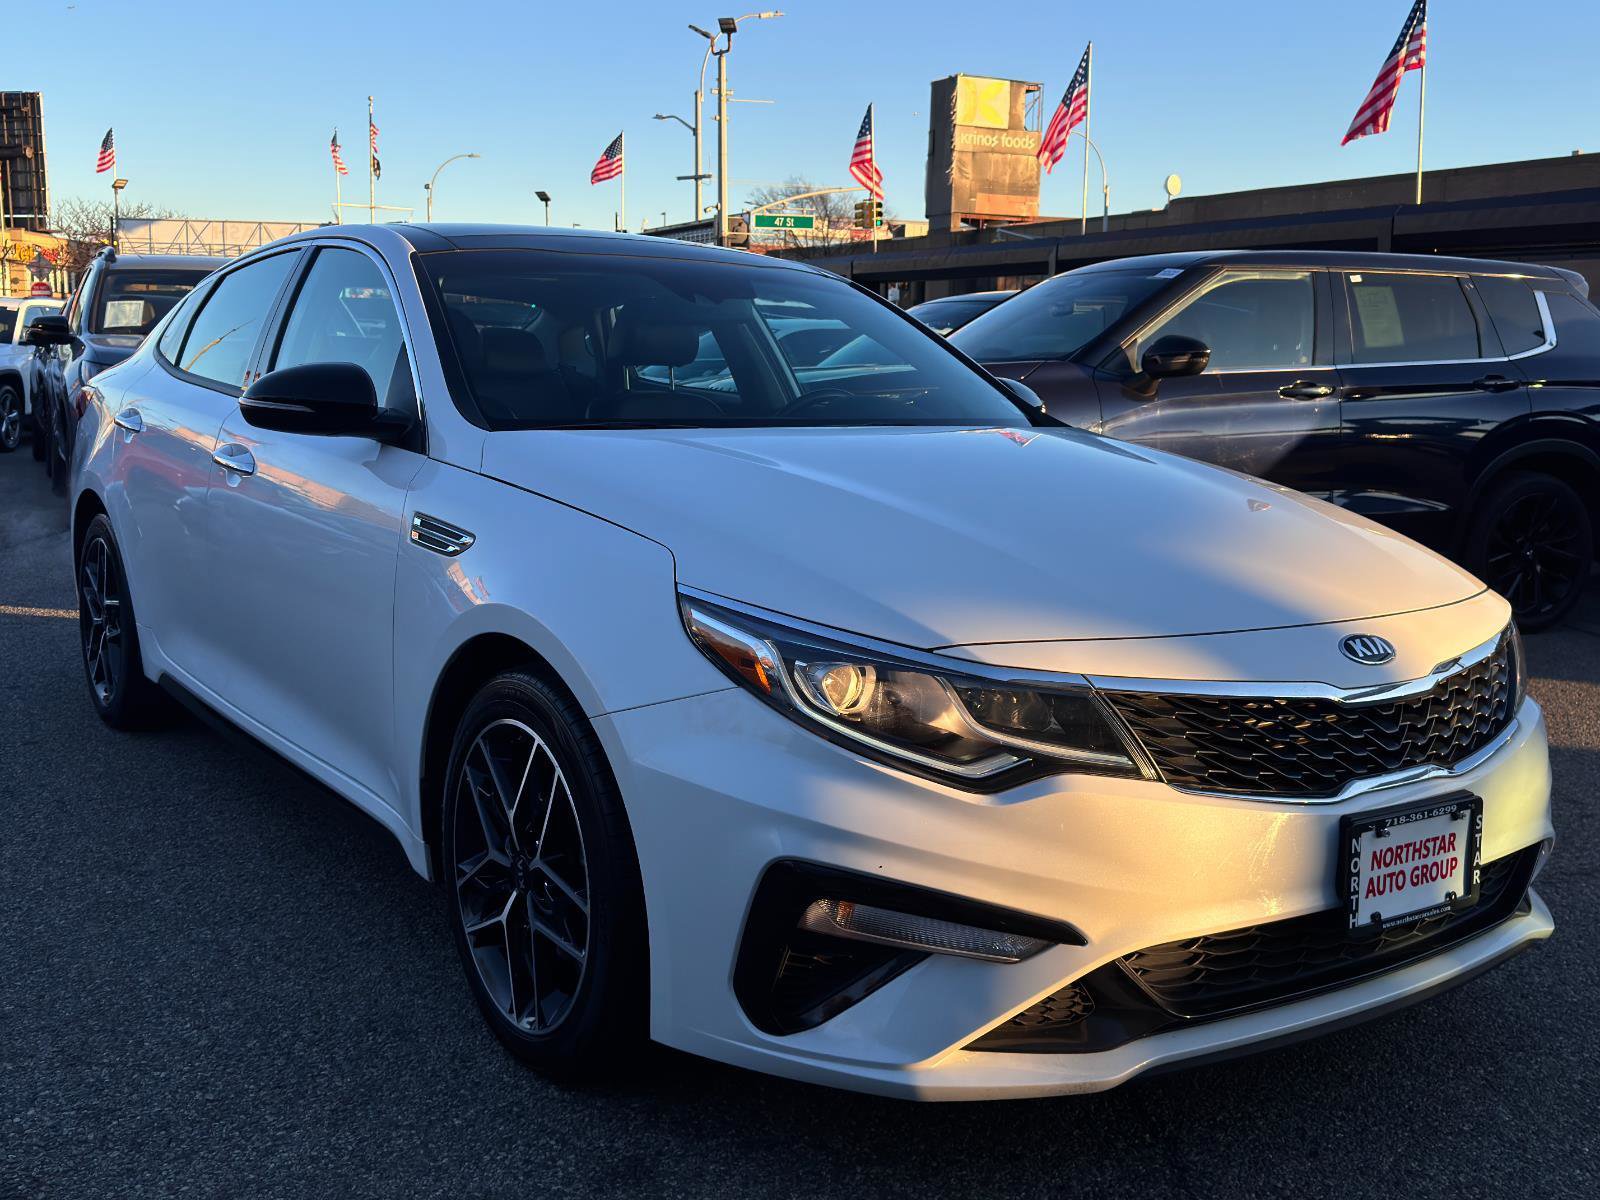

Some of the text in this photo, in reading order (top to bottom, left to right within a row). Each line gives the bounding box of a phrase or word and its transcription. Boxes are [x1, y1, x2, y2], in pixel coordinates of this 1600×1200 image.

[1000, 133, 1036, 149] foods
[774, 217, 794, 227] 47 St
[1346, 637, 1392, 657] KIA
[1386, 805, 1457, 827] 718-361-6299
[1370, 832, 1457, 871] NORTHSTAR
[1474, 815, 1483, 885] STAR
[1350, 838, 1361, 929] NORTH
[1365, 857, 1458, 899] AUTO GROUP
